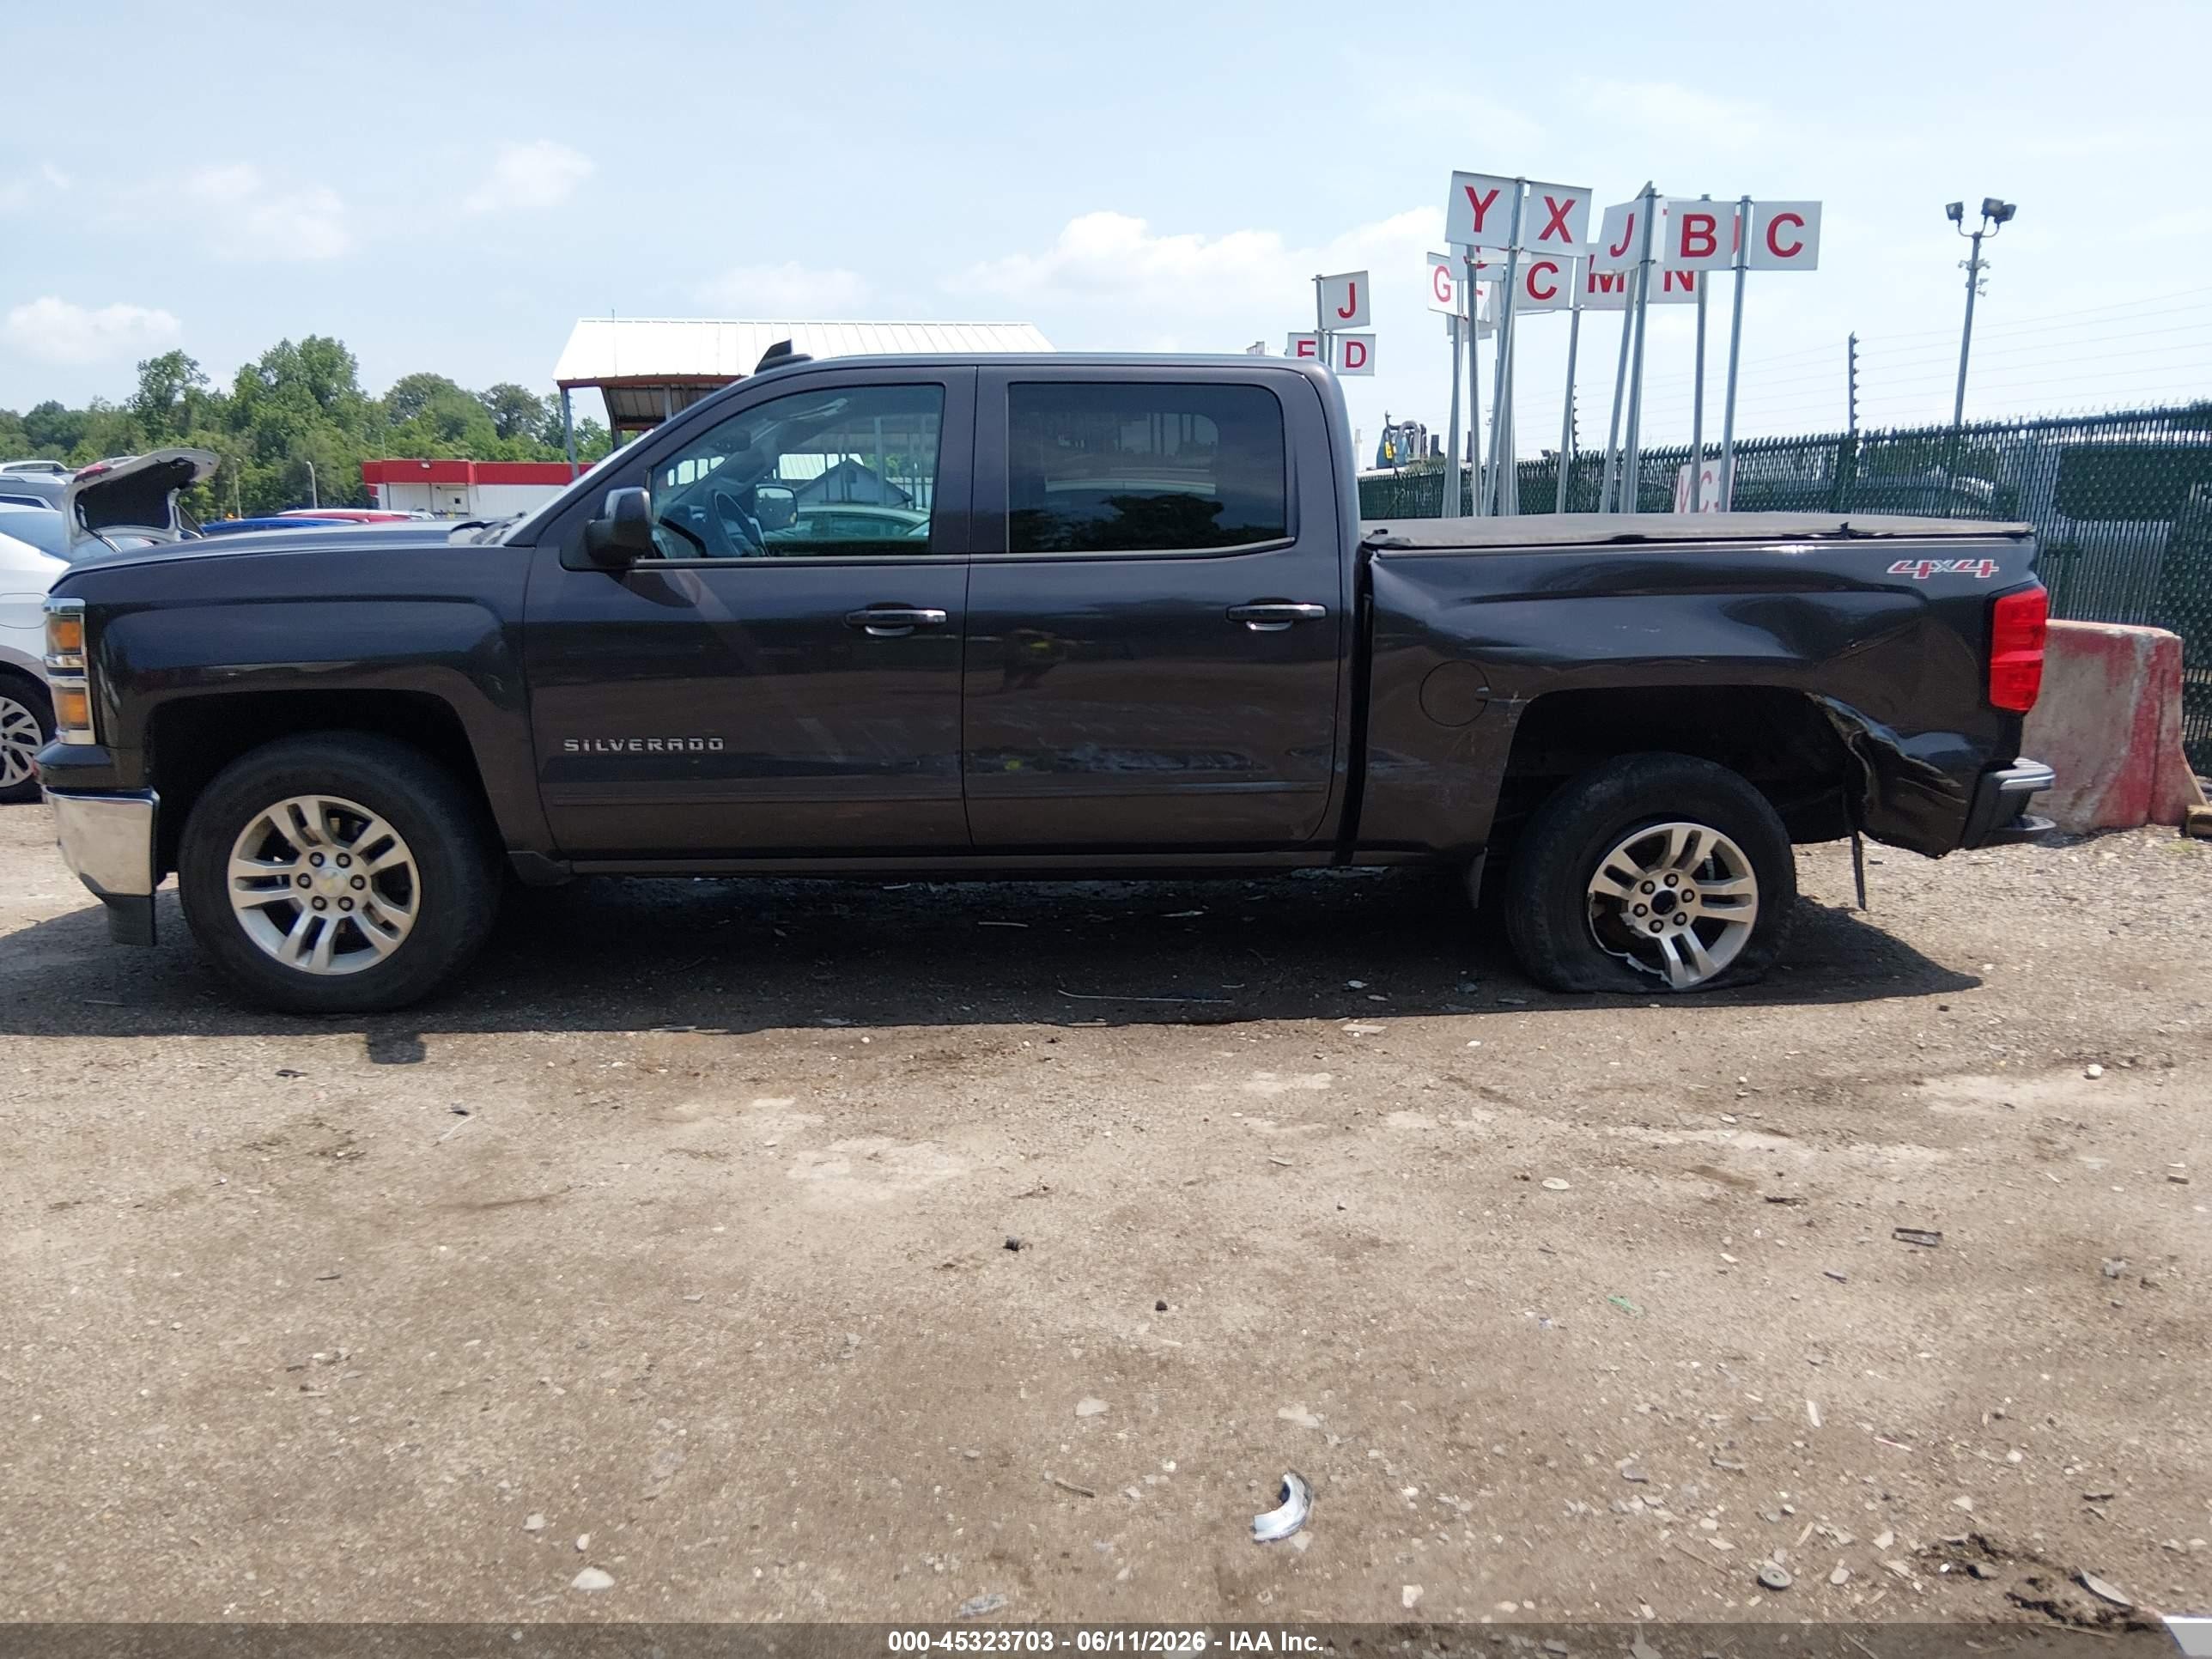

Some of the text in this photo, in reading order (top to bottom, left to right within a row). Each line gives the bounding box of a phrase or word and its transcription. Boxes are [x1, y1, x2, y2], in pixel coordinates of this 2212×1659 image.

[1464, 185, 1500, 233] Y
[1538, 196, 1576, 243] X
[1610, 213, 1635, 258] J
[1680, 214, 1717, 258] B
[1766, 213, 1806, 258] C
[1337, 282, 1357, 319] J
[1433, 265, 1451, 302] G
[1526, 261, 1559, 300] C
[1345, 341, 1367, 368] D
[563, 738, 724, 752] SILVERADO
